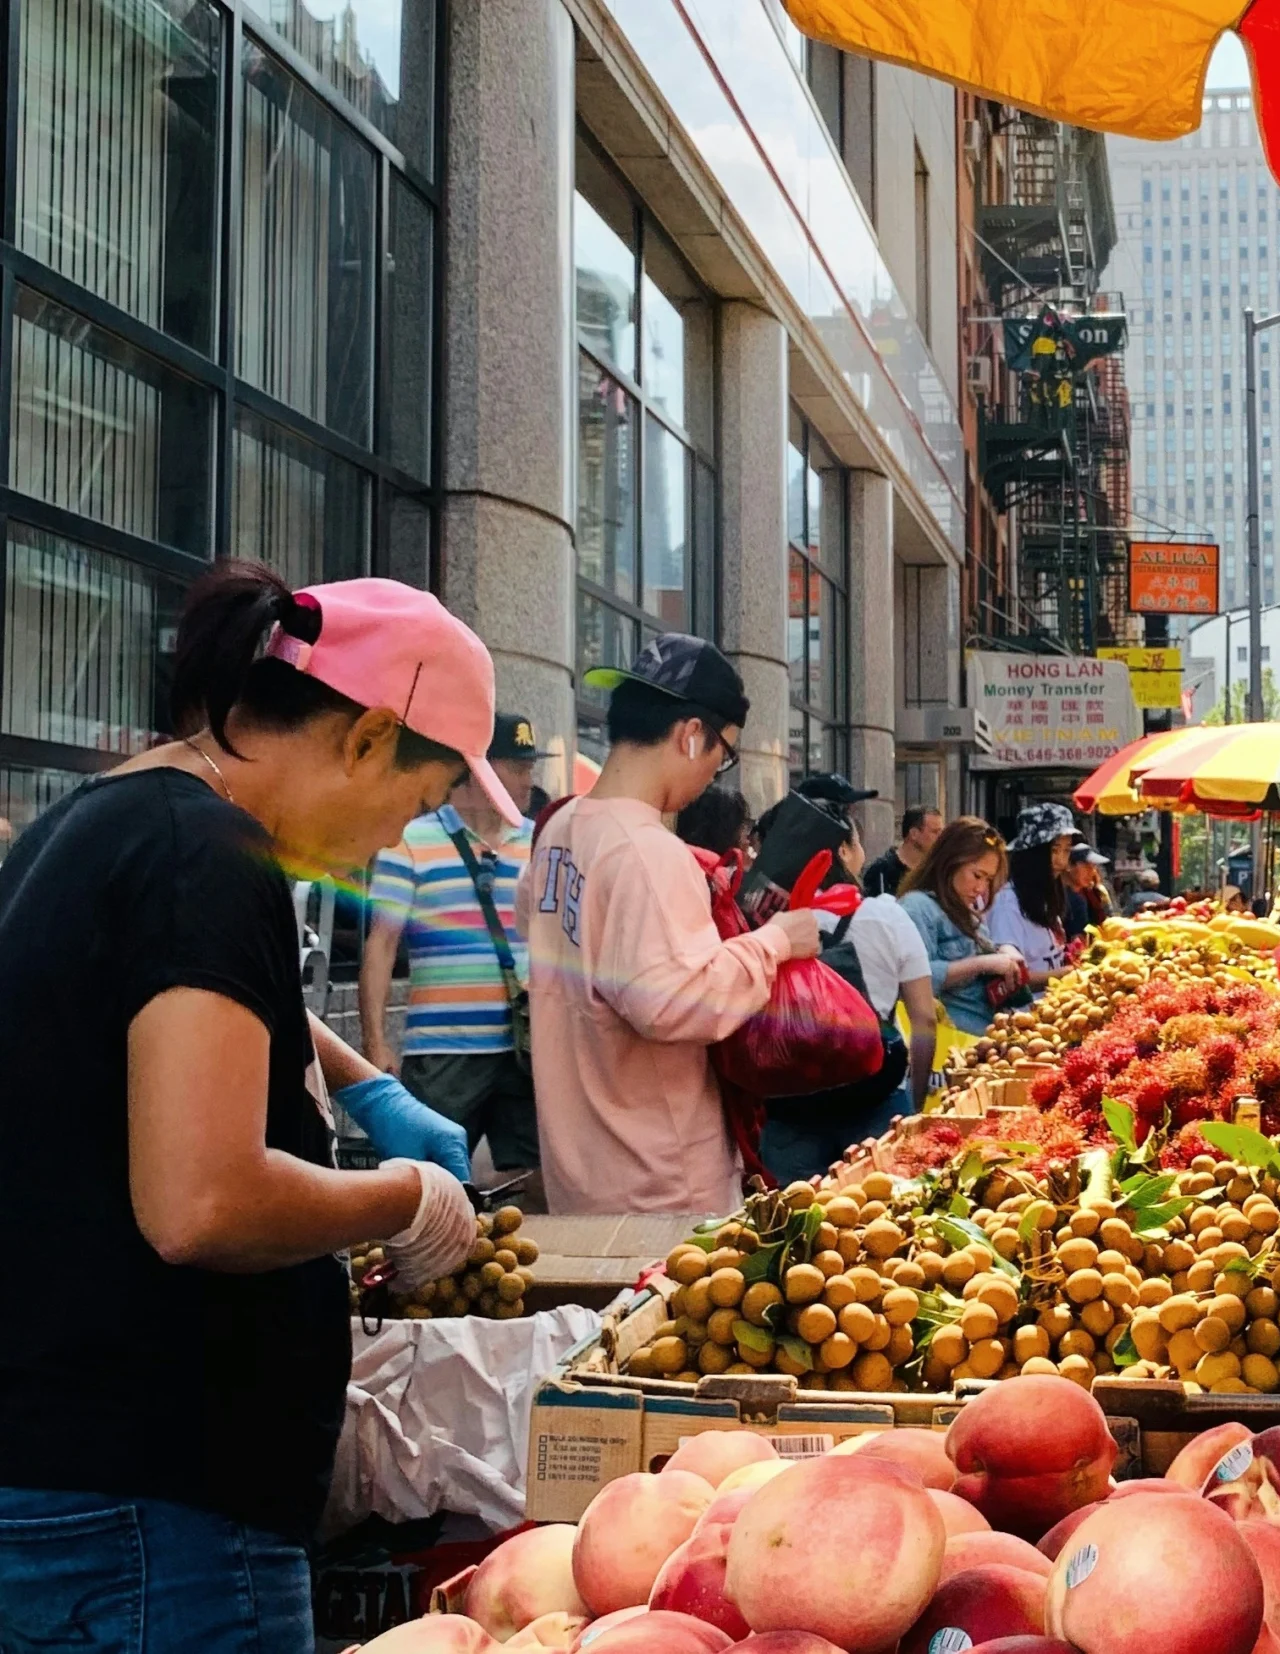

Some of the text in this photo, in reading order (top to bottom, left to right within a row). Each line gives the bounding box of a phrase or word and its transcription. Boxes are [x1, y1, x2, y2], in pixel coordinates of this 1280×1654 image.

[1007, 663, 1104, 679] HONG LAN
[984, 683, 1105, 698] Money Transfer
